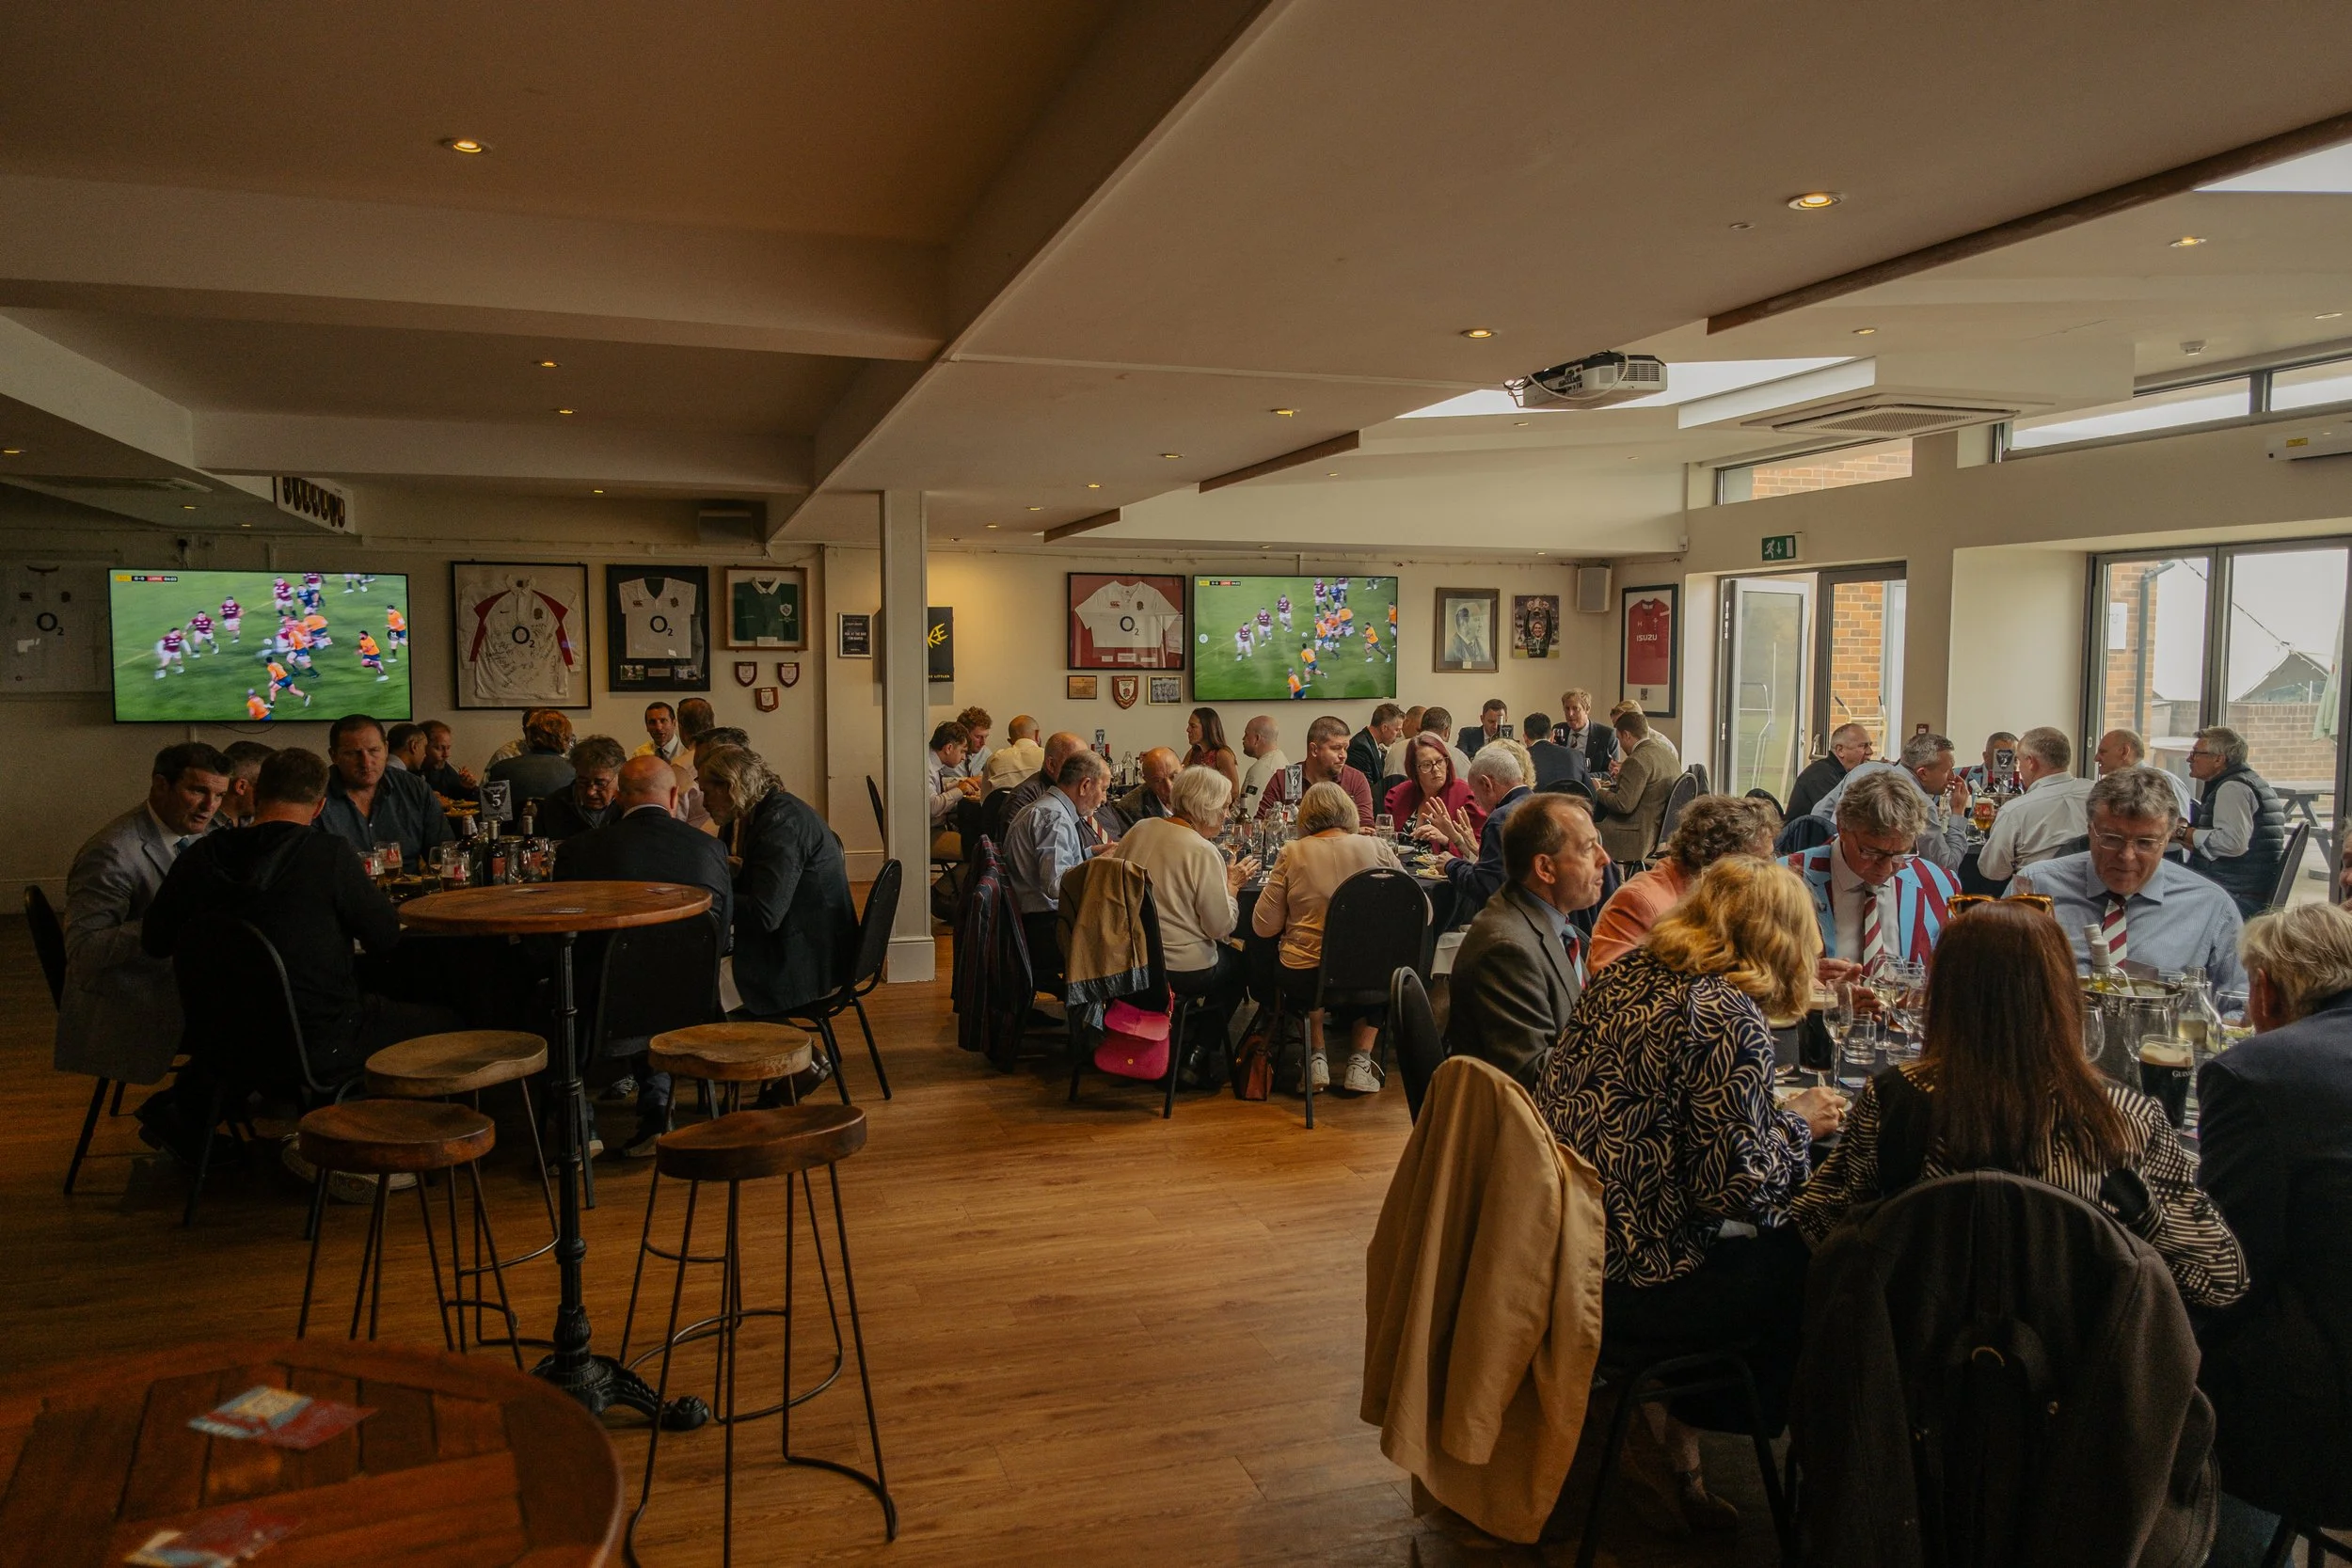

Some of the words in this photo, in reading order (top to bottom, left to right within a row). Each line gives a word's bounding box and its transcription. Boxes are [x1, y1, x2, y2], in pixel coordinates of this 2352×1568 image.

[2001, 757, 2008, 768] 2
[1292, 775, 1297, 785] 6
[492, 794, 501, 807] 5
